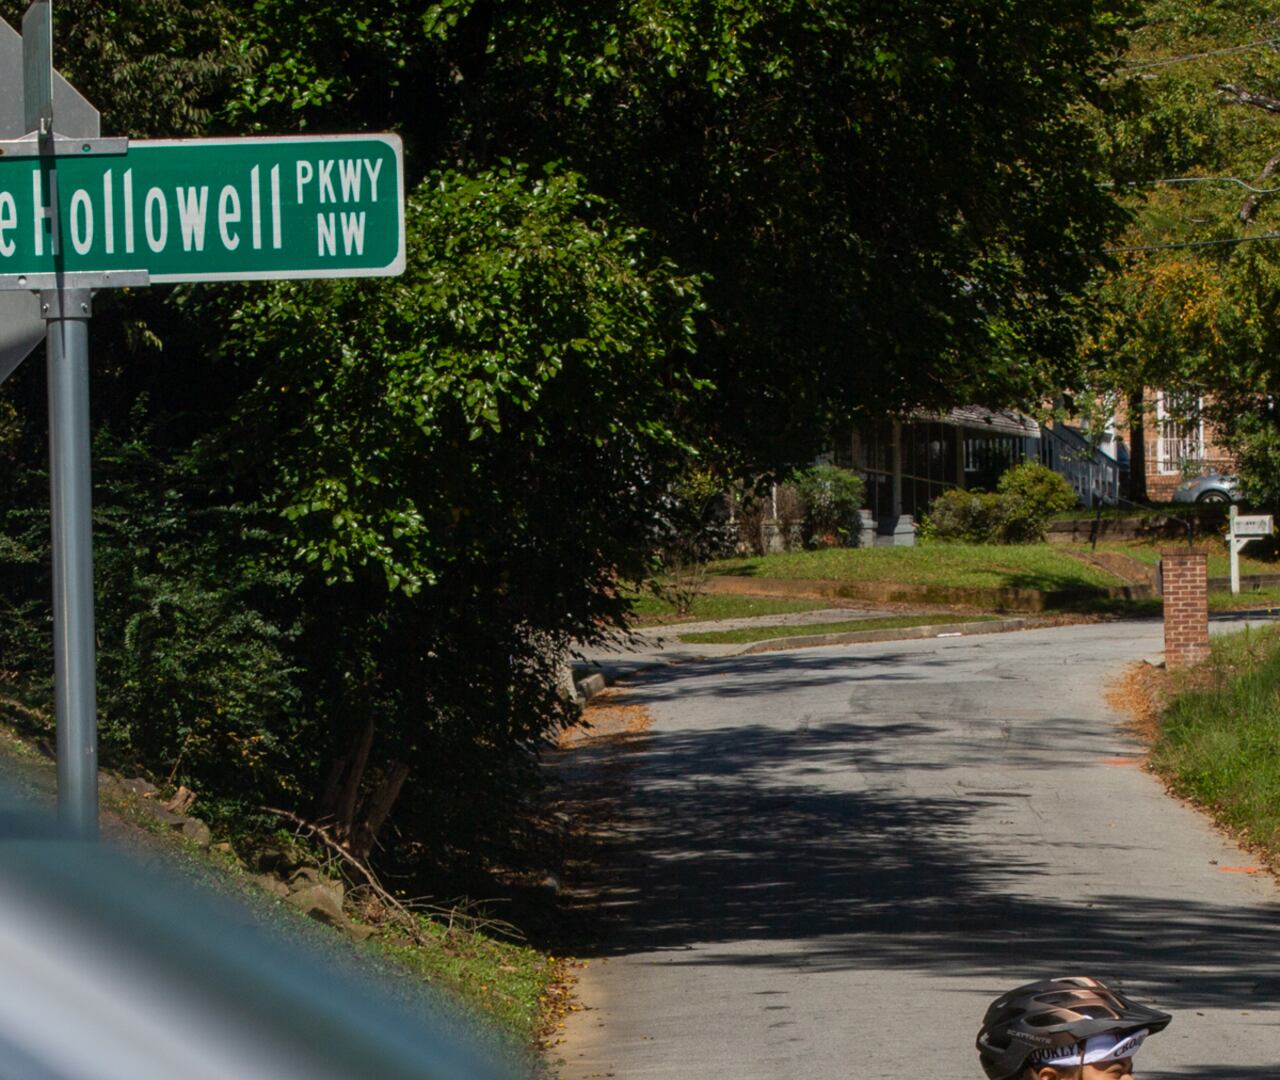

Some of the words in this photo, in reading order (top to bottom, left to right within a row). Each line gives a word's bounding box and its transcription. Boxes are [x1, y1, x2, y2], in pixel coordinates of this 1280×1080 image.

[296, 158, 383, 204] PKWY
[32, 161, 283, 257] Hollowell
[317, 211, 366, 257] NW
